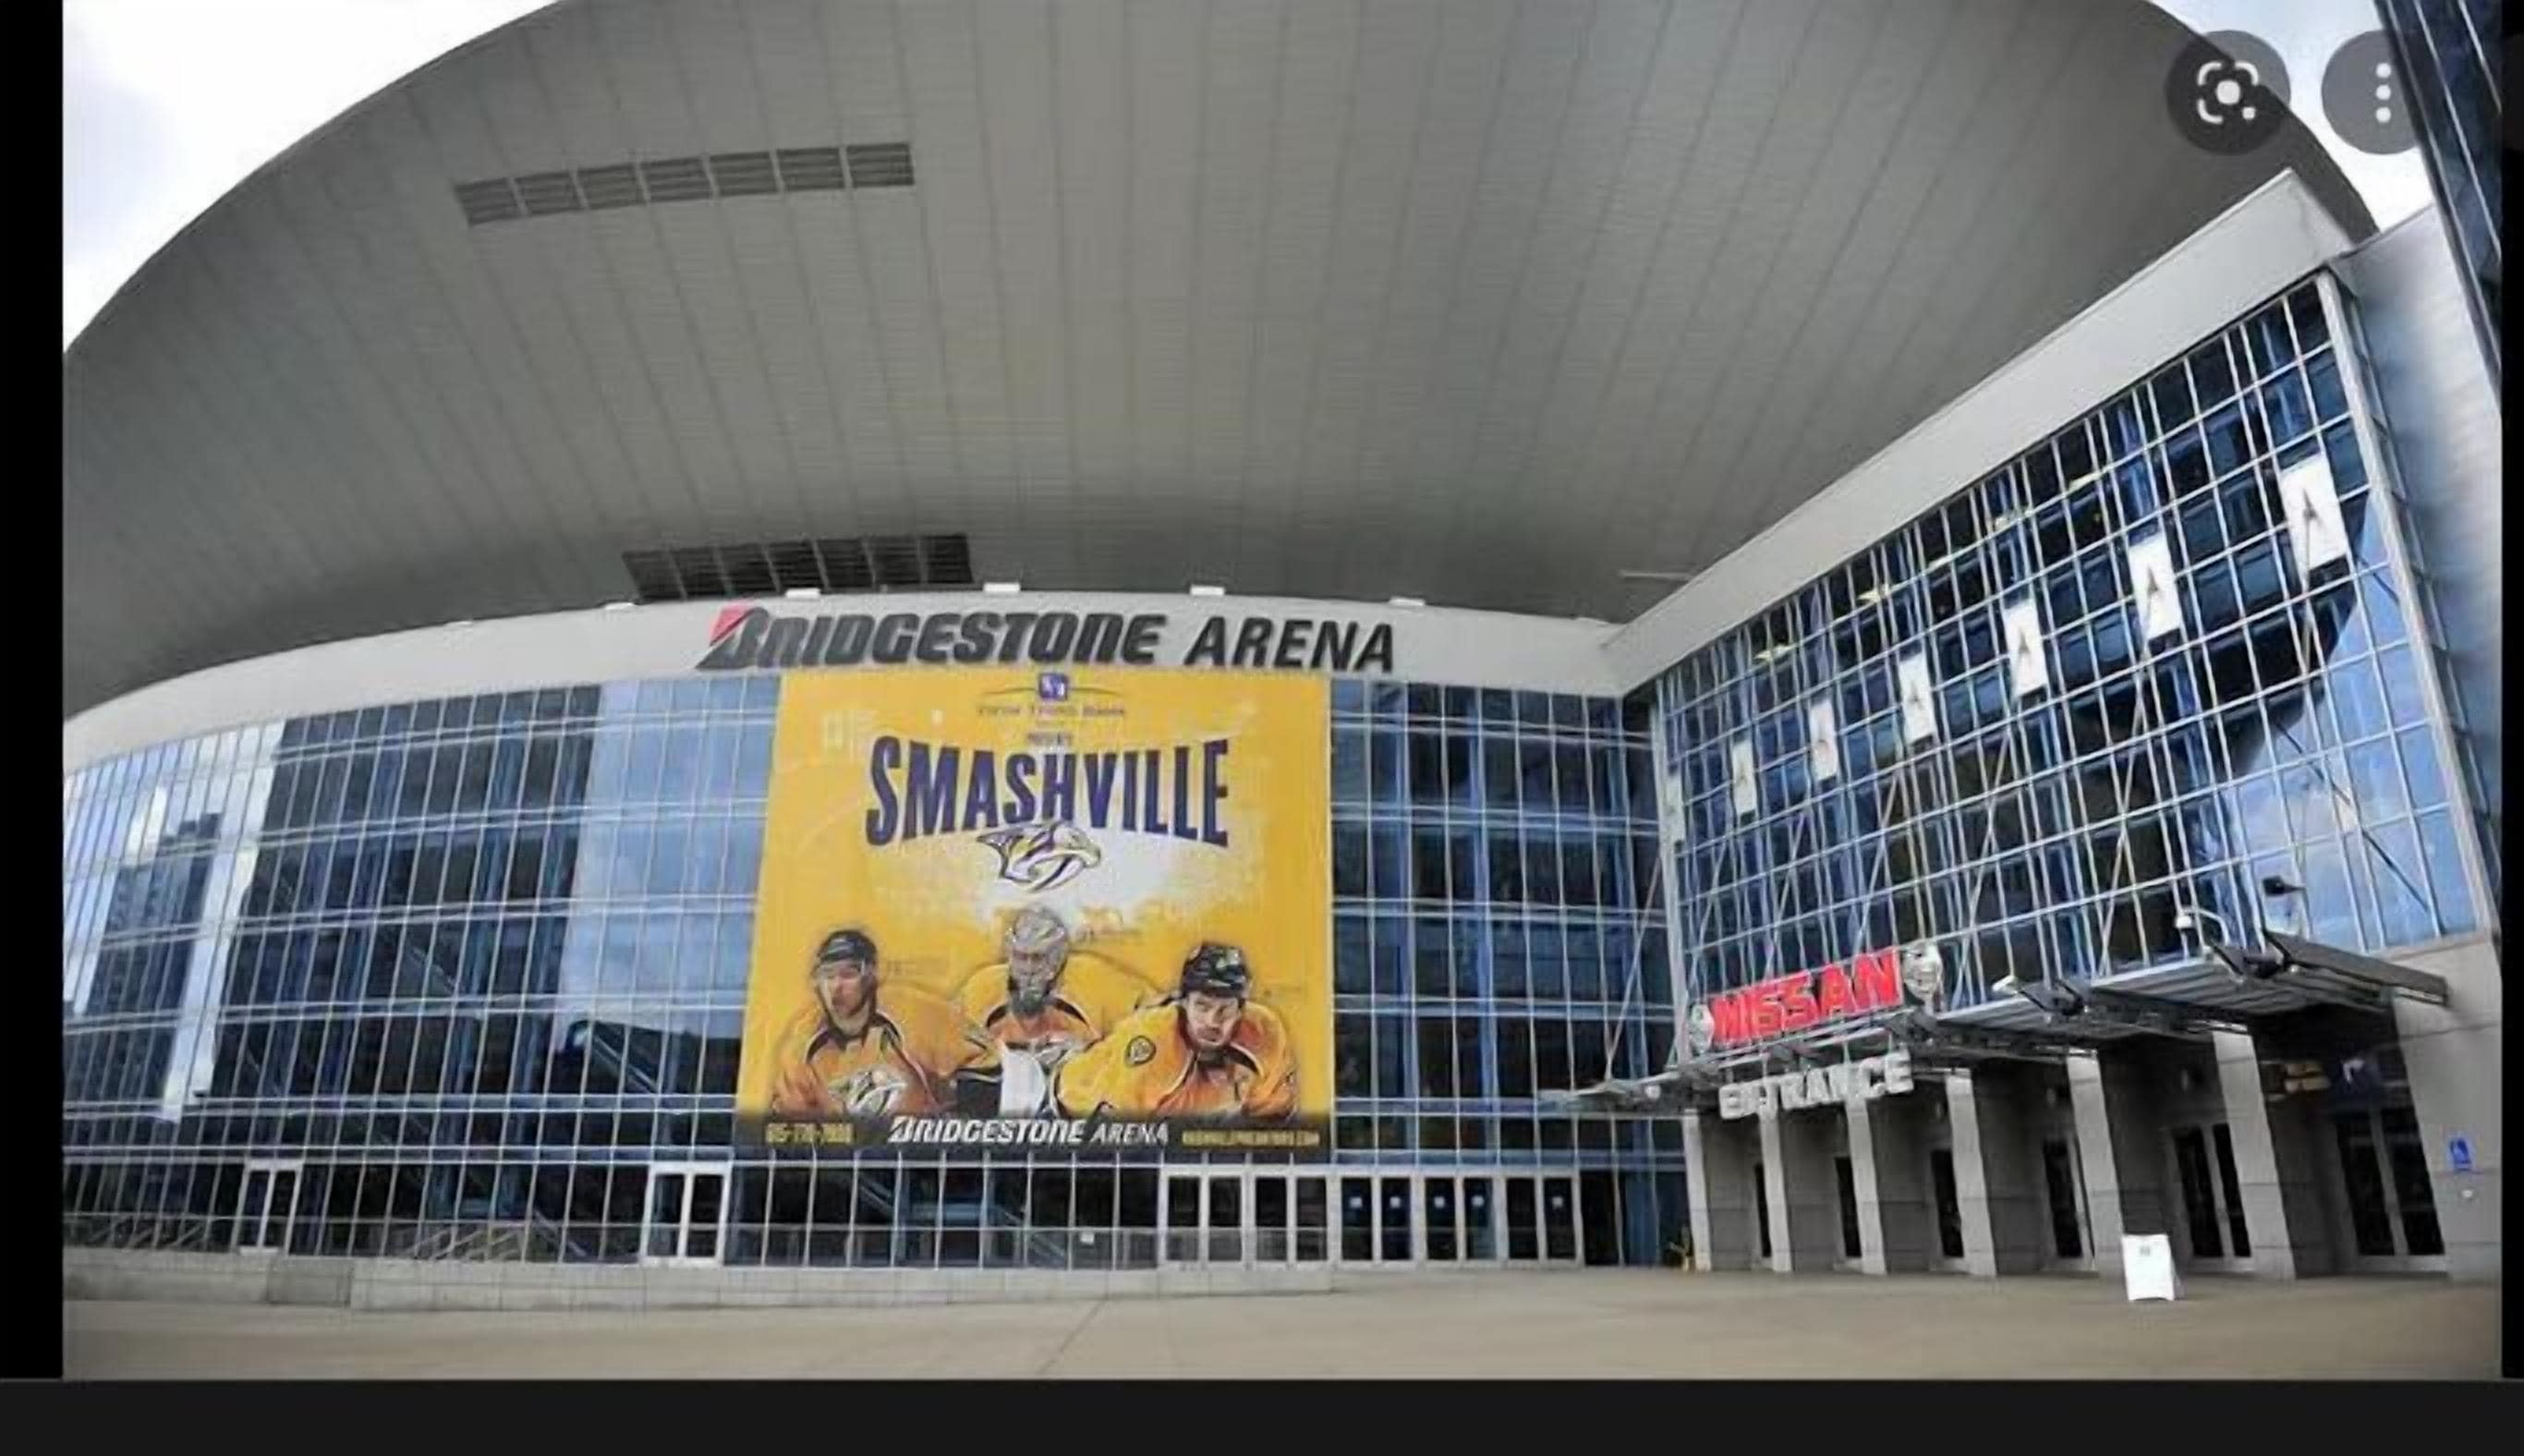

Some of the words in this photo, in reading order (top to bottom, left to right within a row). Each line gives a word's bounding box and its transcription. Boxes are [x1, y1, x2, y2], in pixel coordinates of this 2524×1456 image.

[695, 602, 1168, 670] BRIDGESTONE
[1183, 615, 1394, 673] ARENA
[866, 735, 1229, 848] SMASHVILLE
[1709, 946, 1903, 1046] NISSAN
[1718, 1049, 1914, 1121] ENTRANCE
[888, 1116, 1087, 1144] BRIDGESTONE
[1088, 1122, 1170, 1146] ARENA
